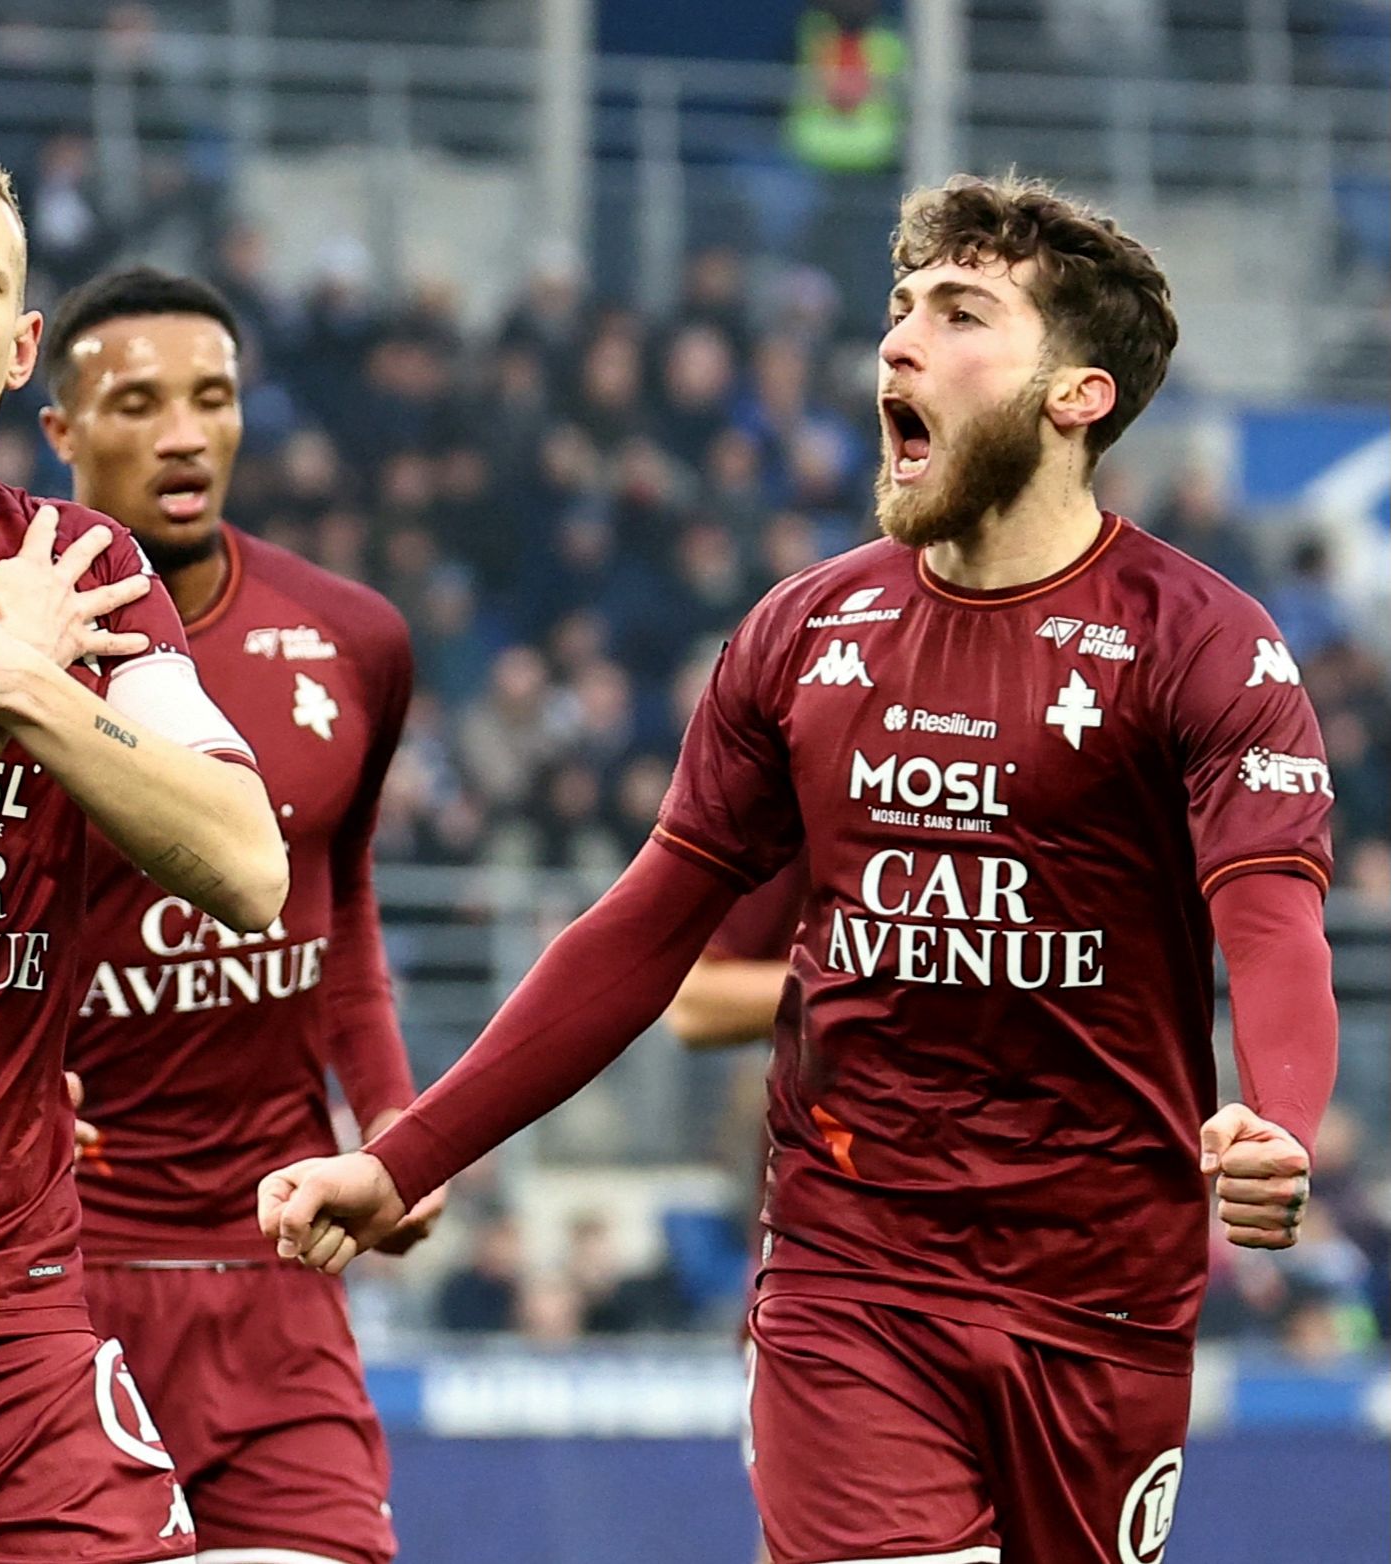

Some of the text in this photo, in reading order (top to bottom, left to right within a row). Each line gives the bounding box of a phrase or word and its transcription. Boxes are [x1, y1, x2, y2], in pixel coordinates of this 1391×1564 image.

[95, 714, 138, 749] VIBES
[911, 709, 997, 739] Resilium
[870, 808, 992, 833] MOSELLE SANS LIMITE
[862, 849, 1034, 924] CAR
[828, 908, 1103, 989] AVENUE
[78, 937, 328, 1017] AVENUE
